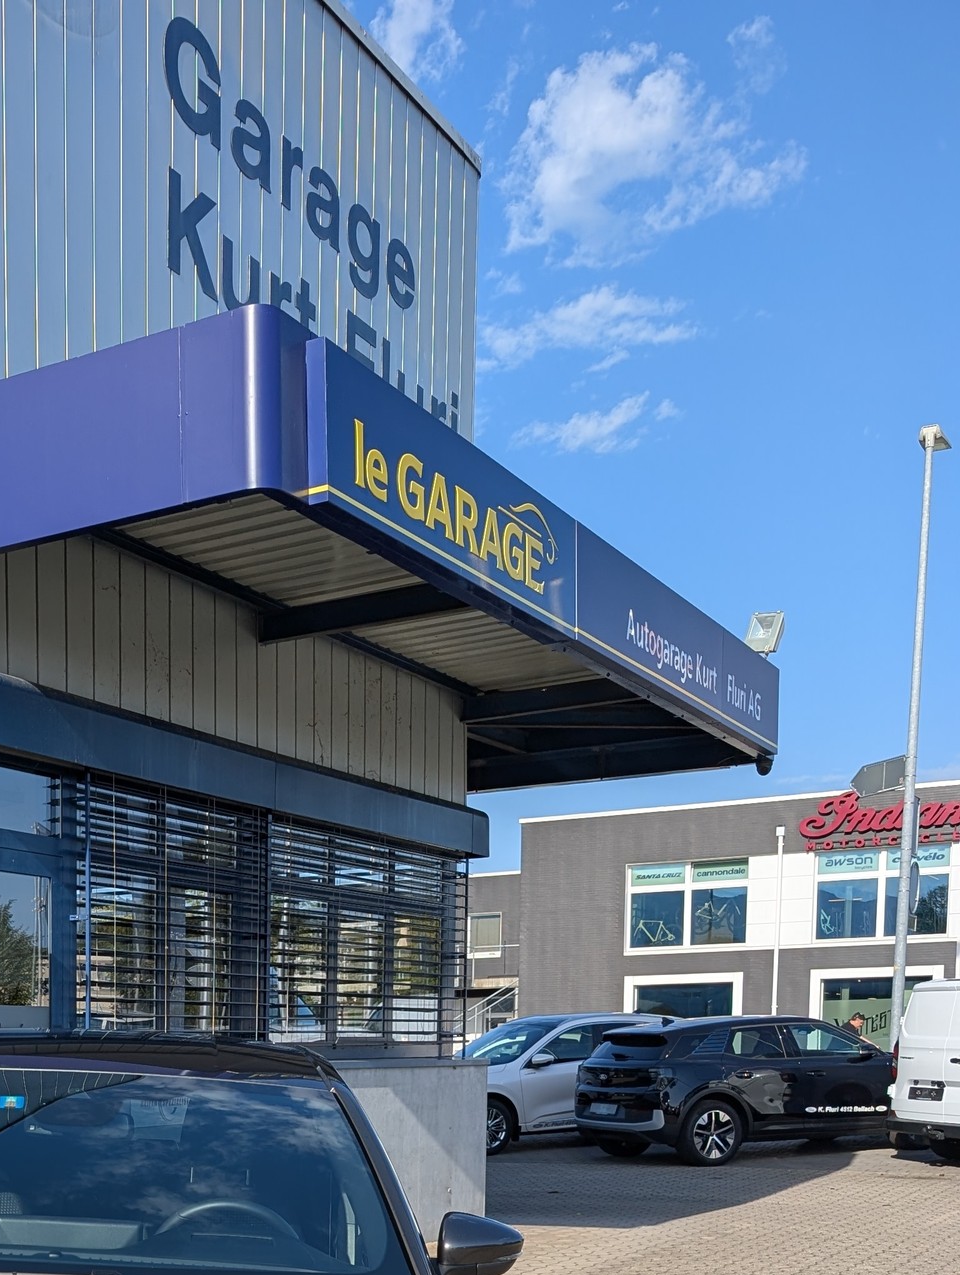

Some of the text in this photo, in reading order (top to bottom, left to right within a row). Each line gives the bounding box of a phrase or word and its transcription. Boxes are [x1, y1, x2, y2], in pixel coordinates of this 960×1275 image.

[164, 16, 415, 310] Garage
[354, 418, 545, 595] le GARAGE
[626, 609, 761, 720] Autogarage Kurt Fluri AG
[799, 791, 960, 839] Indan
[805, 831, 960, 852] MOTORCCLE
[696, 868, 746, 877] cannondale
